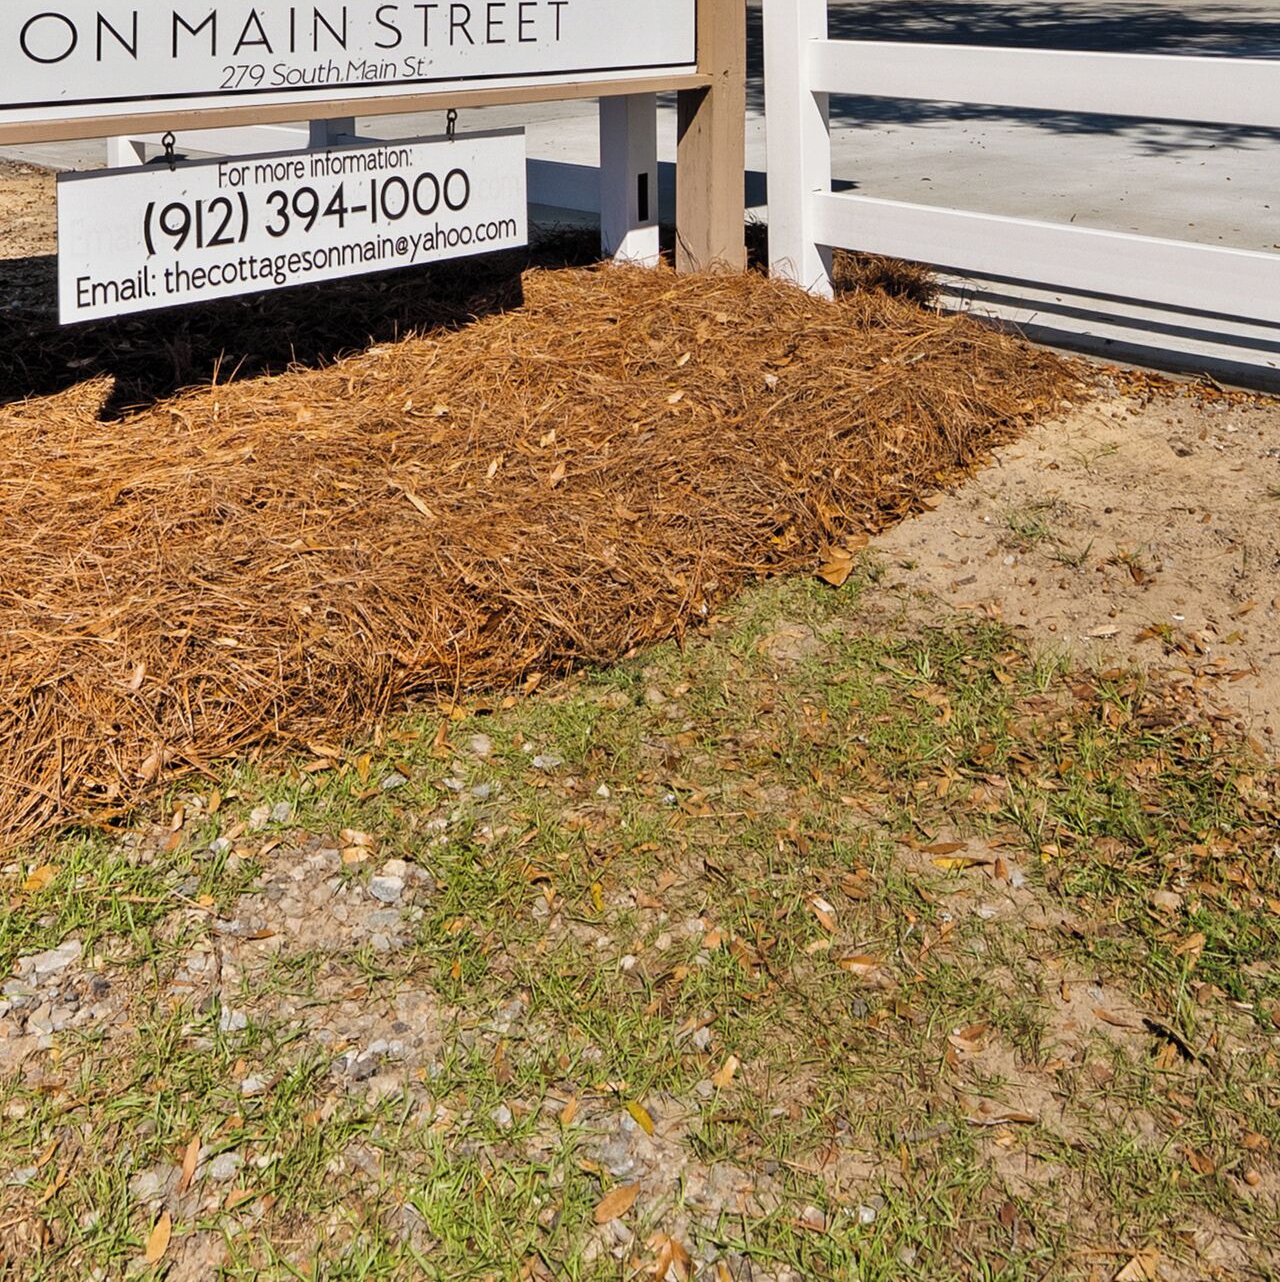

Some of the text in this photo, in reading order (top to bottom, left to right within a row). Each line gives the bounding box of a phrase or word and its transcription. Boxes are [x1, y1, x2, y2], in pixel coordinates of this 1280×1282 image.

[19, 0, 569, 64] ON MAIN STREET
[219, 64, 265, 89] 279
[270, 59, 341, 86] South
[346, 59, 397, 82] Main
[218, 148, 413, 189] For more information:
[143, 168, 471, 256] (912) 394-1000
[76, 218, 517, 309] Email: thecottagesonmain@yahoo.com
